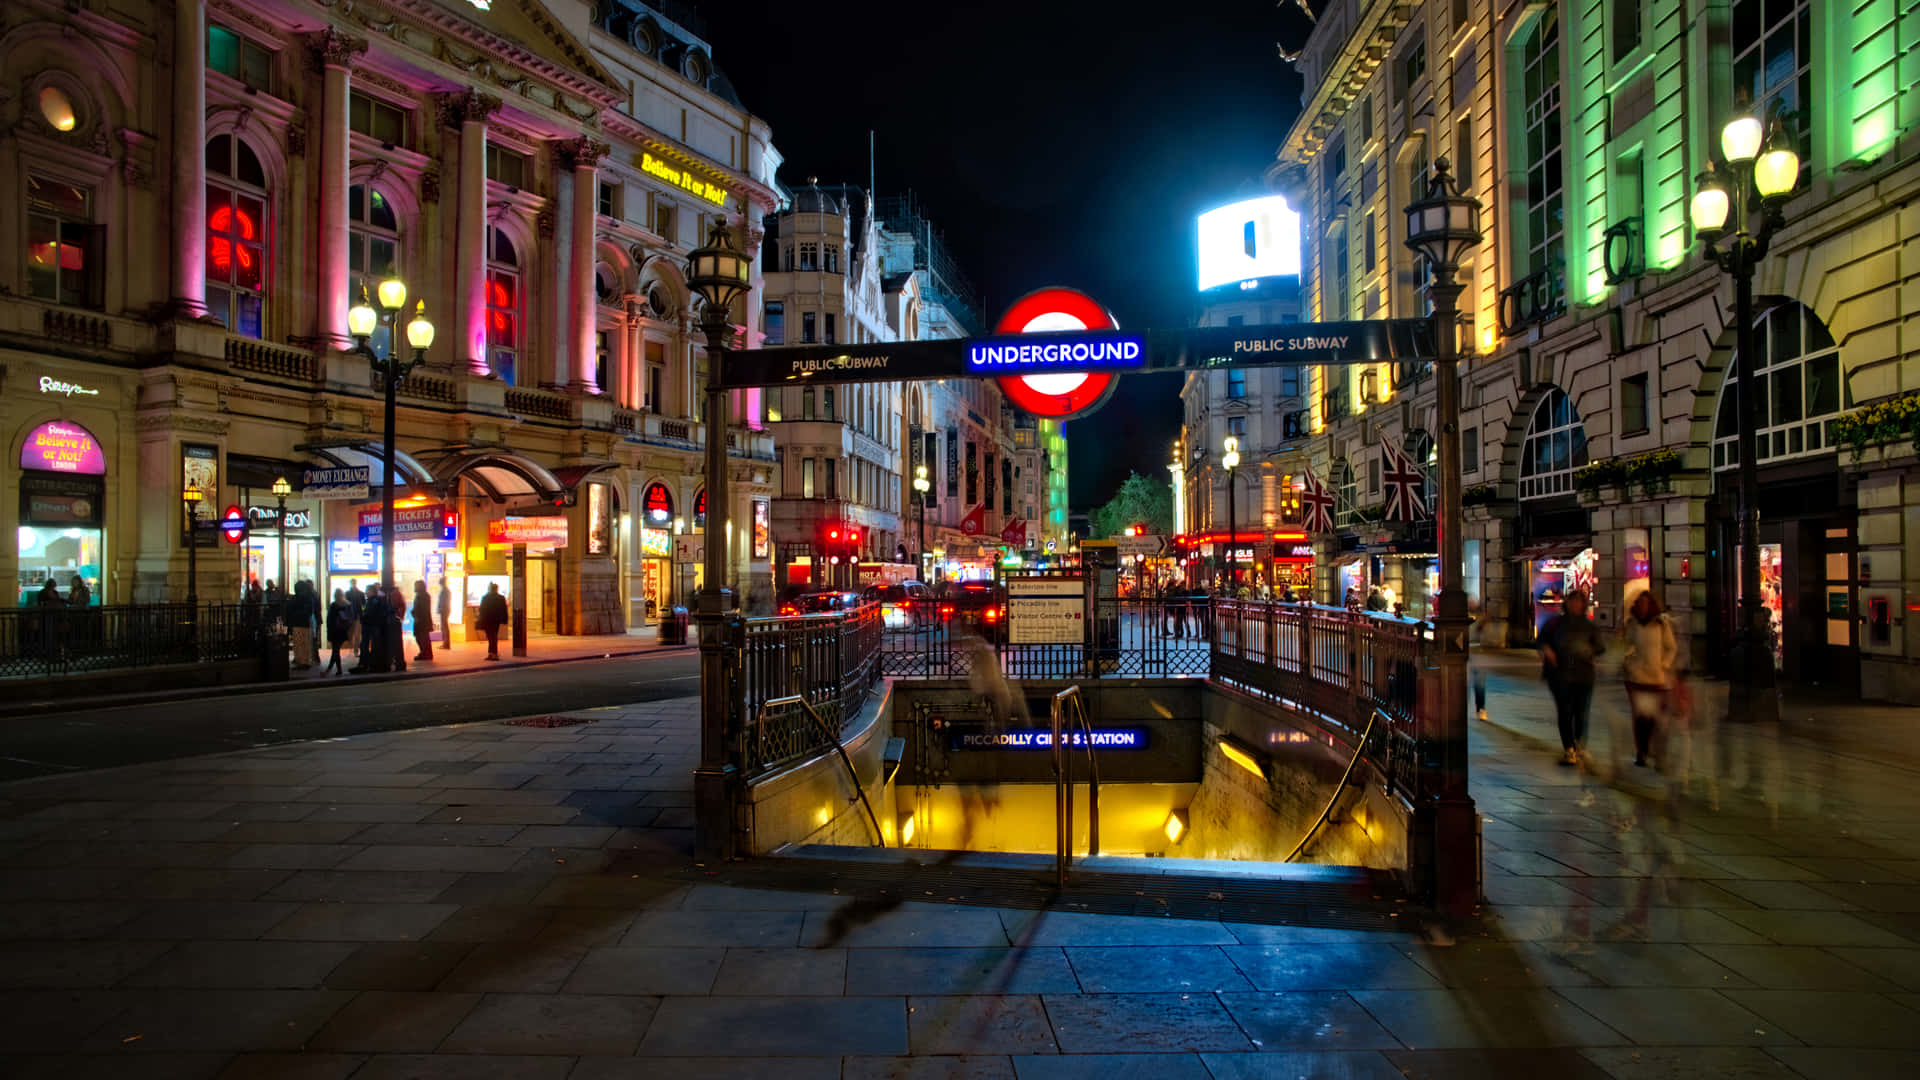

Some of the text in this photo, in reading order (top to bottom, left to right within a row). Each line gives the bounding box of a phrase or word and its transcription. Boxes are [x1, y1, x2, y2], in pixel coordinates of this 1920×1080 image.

[641, 153, 727, 205] Believe It or Not!
[1234, 336, 1349, 352] PUBLIC SUBWAY
[972, 342, 1139, 364] UNDERGROUND
[792, 356, 889, 372] PUBLIC SUBWAY
[36, 434, 91, 450] Believe It
[43, 449, 83, 462] or Not!
[312, 468, 368, 483] MONEY EXCHANGE
[248, 507, 311, 527] CINNBON
[399, 509, 432, 521] TICKETS
[963, 734, 1033, 746] PICCADILLY
[1036, 733, 1081, 745] CIS
